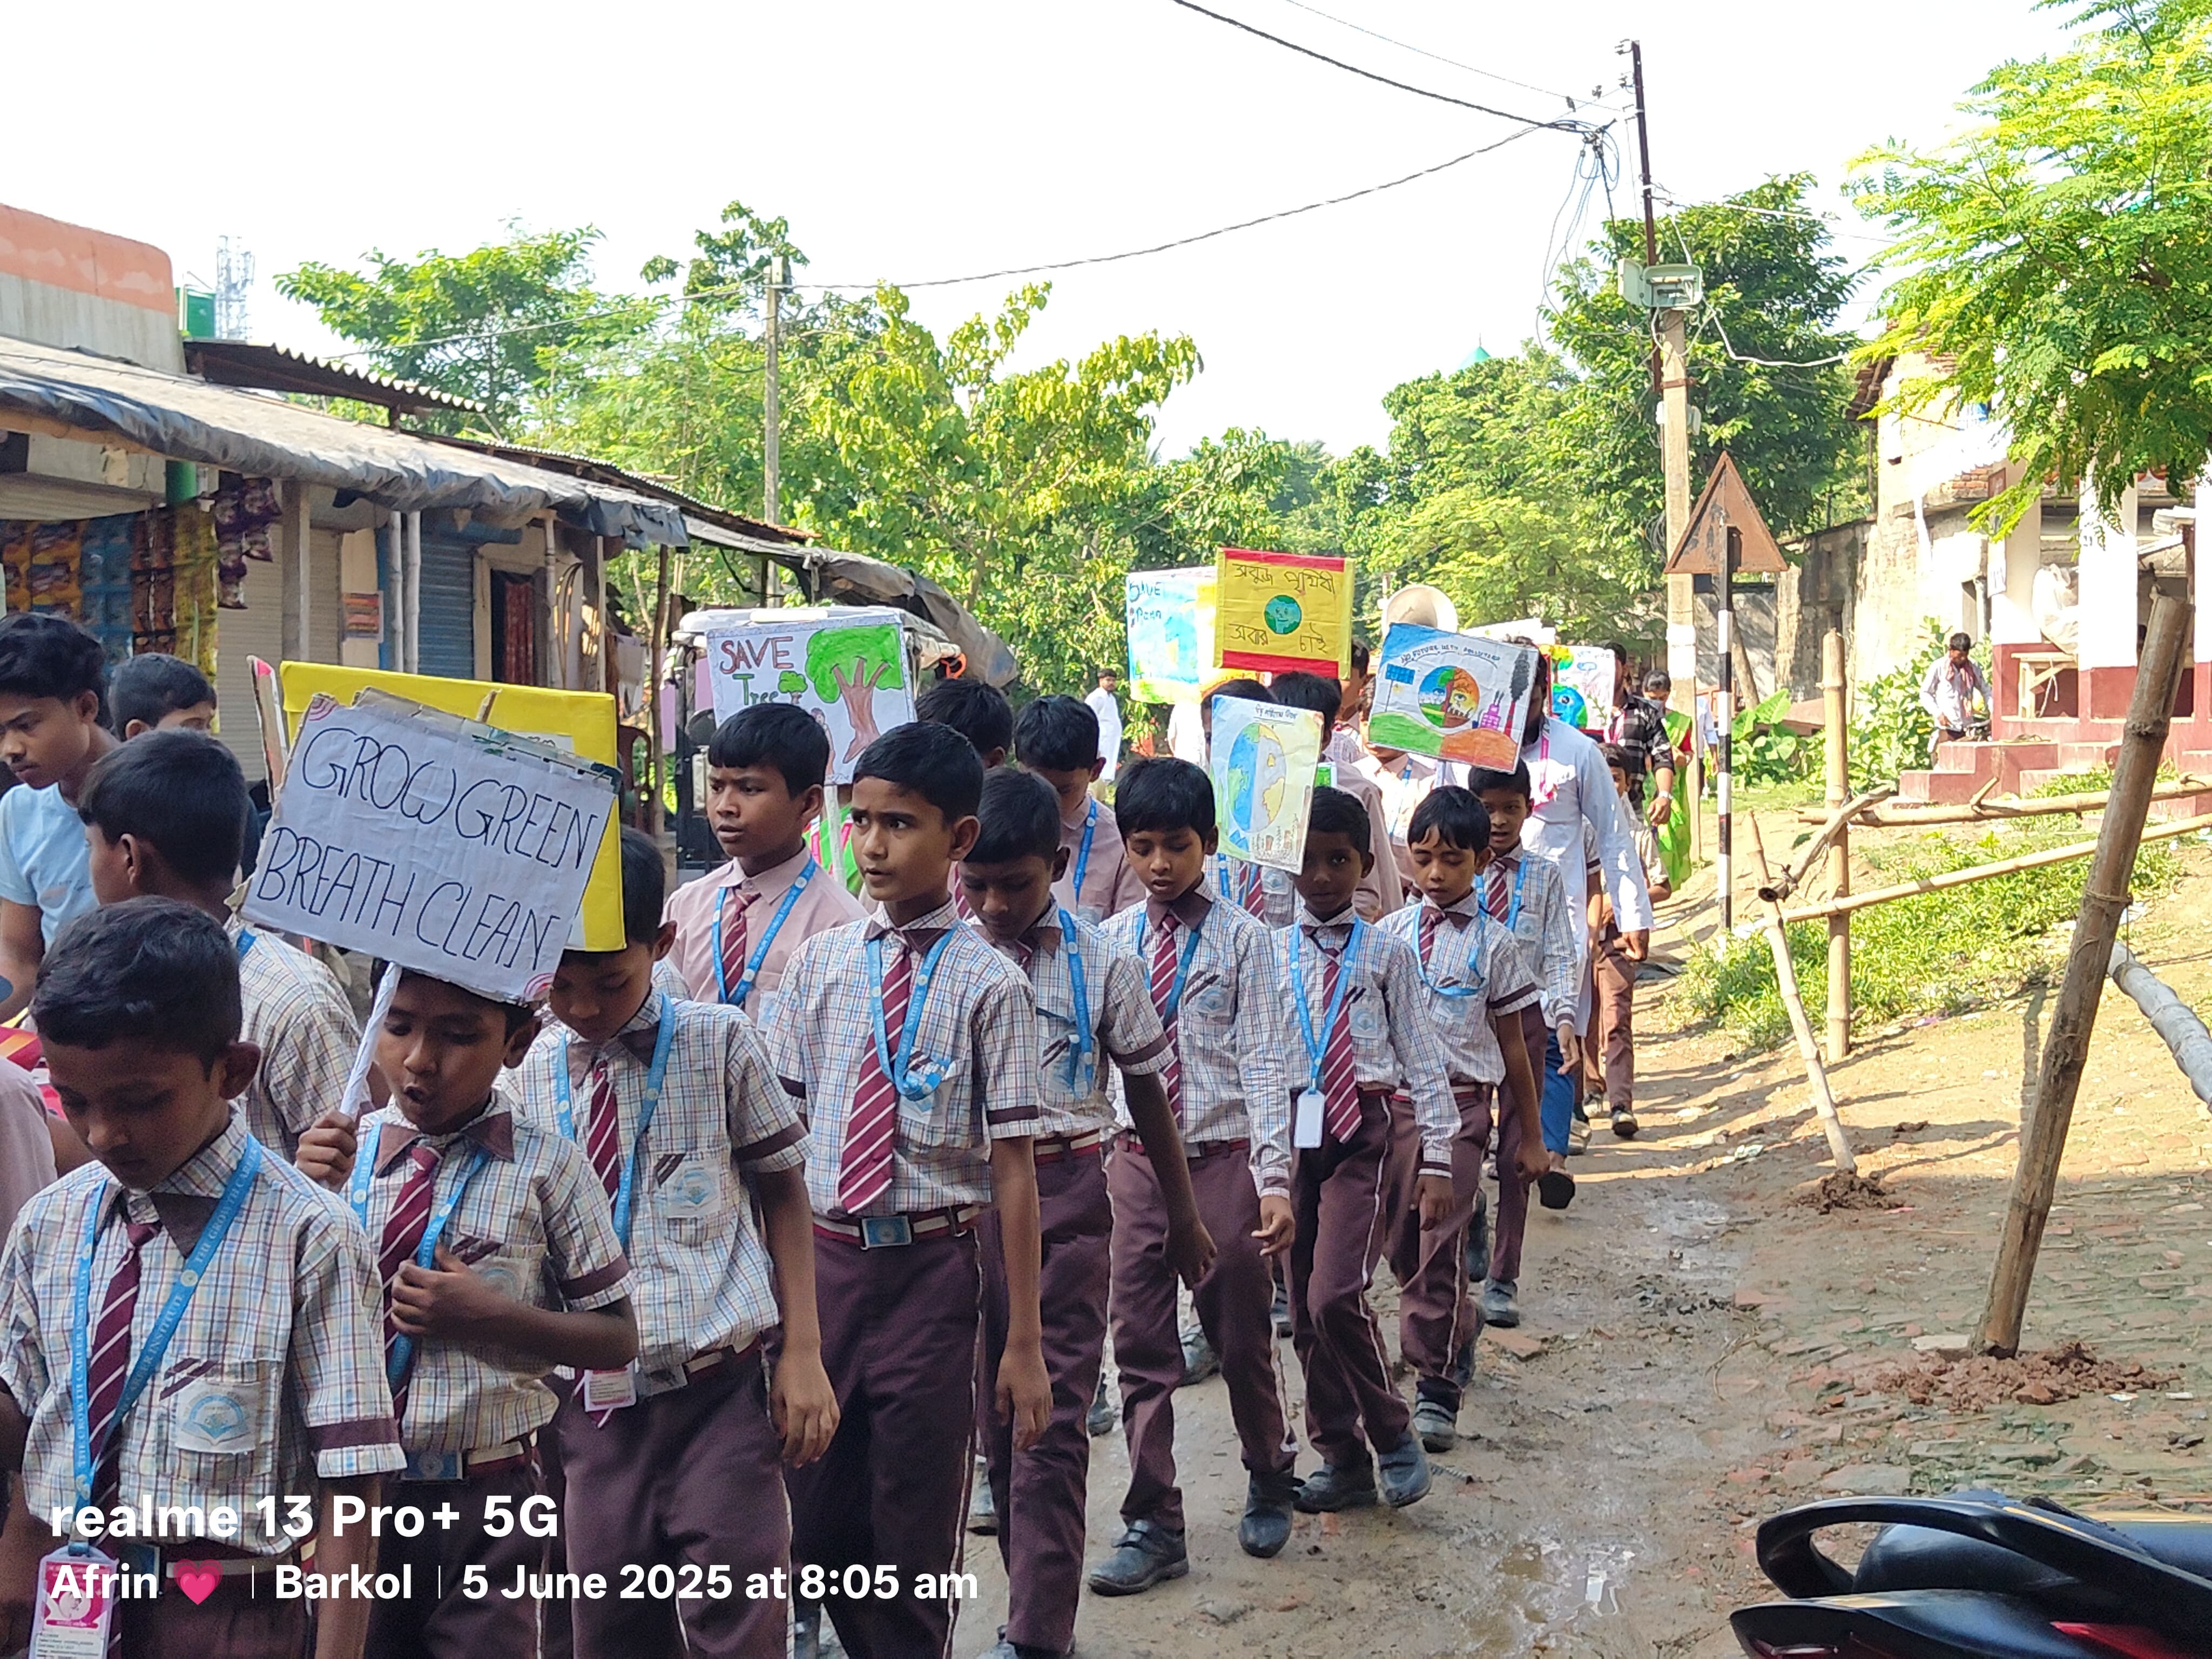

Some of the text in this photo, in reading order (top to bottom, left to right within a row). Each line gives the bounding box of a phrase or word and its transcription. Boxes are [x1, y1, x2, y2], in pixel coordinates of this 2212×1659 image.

[720, 636, 795, 674] SAVE
[732, 673, 779, 706] Tree
[301, 727, 598, 869] GROW GREEN
[257, 827, 561, 971] BREATH CLEAN
